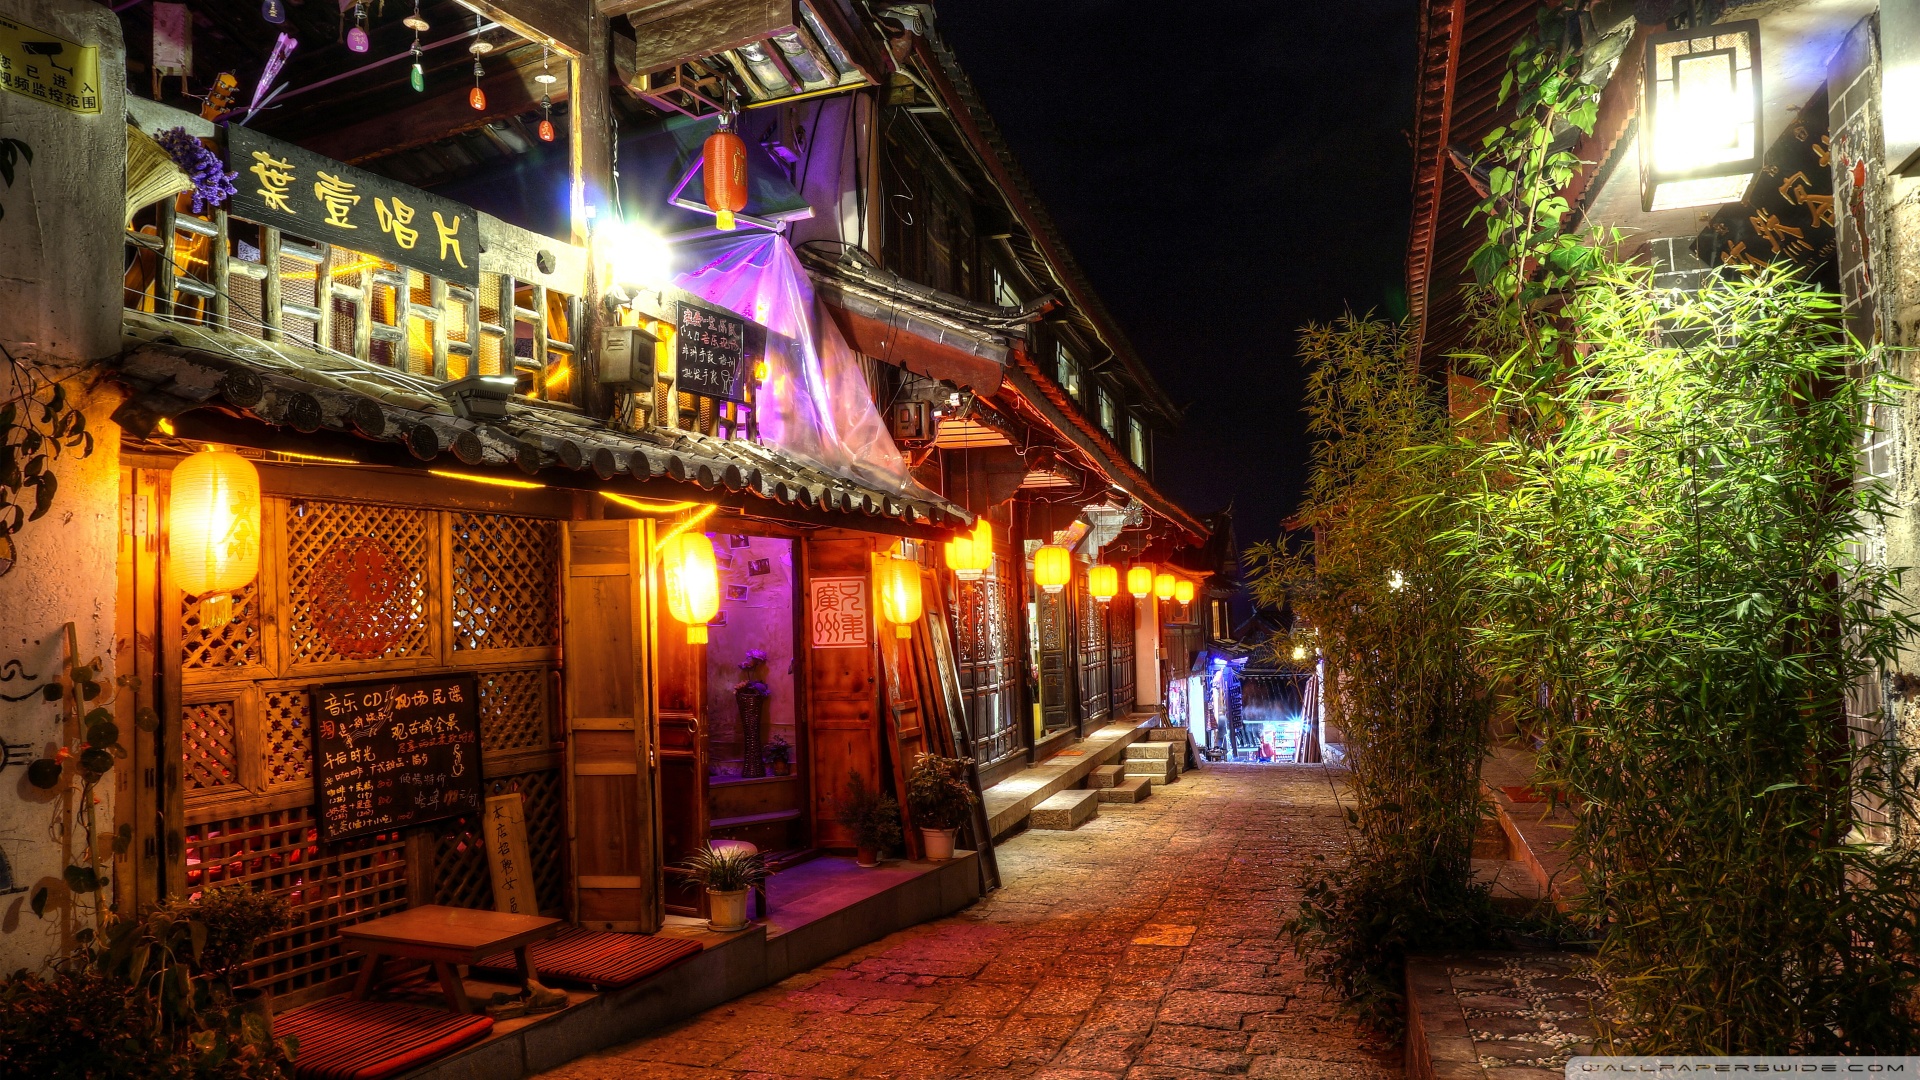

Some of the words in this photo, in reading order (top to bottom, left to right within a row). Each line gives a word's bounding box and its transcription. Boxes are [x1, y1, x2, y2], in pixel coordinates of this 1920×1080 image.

[249, 150, 469, 269] 葉壹唱片
[391, 713, 461, 741] 观古城全景
[323, 745, 376, 771] 午后时光
